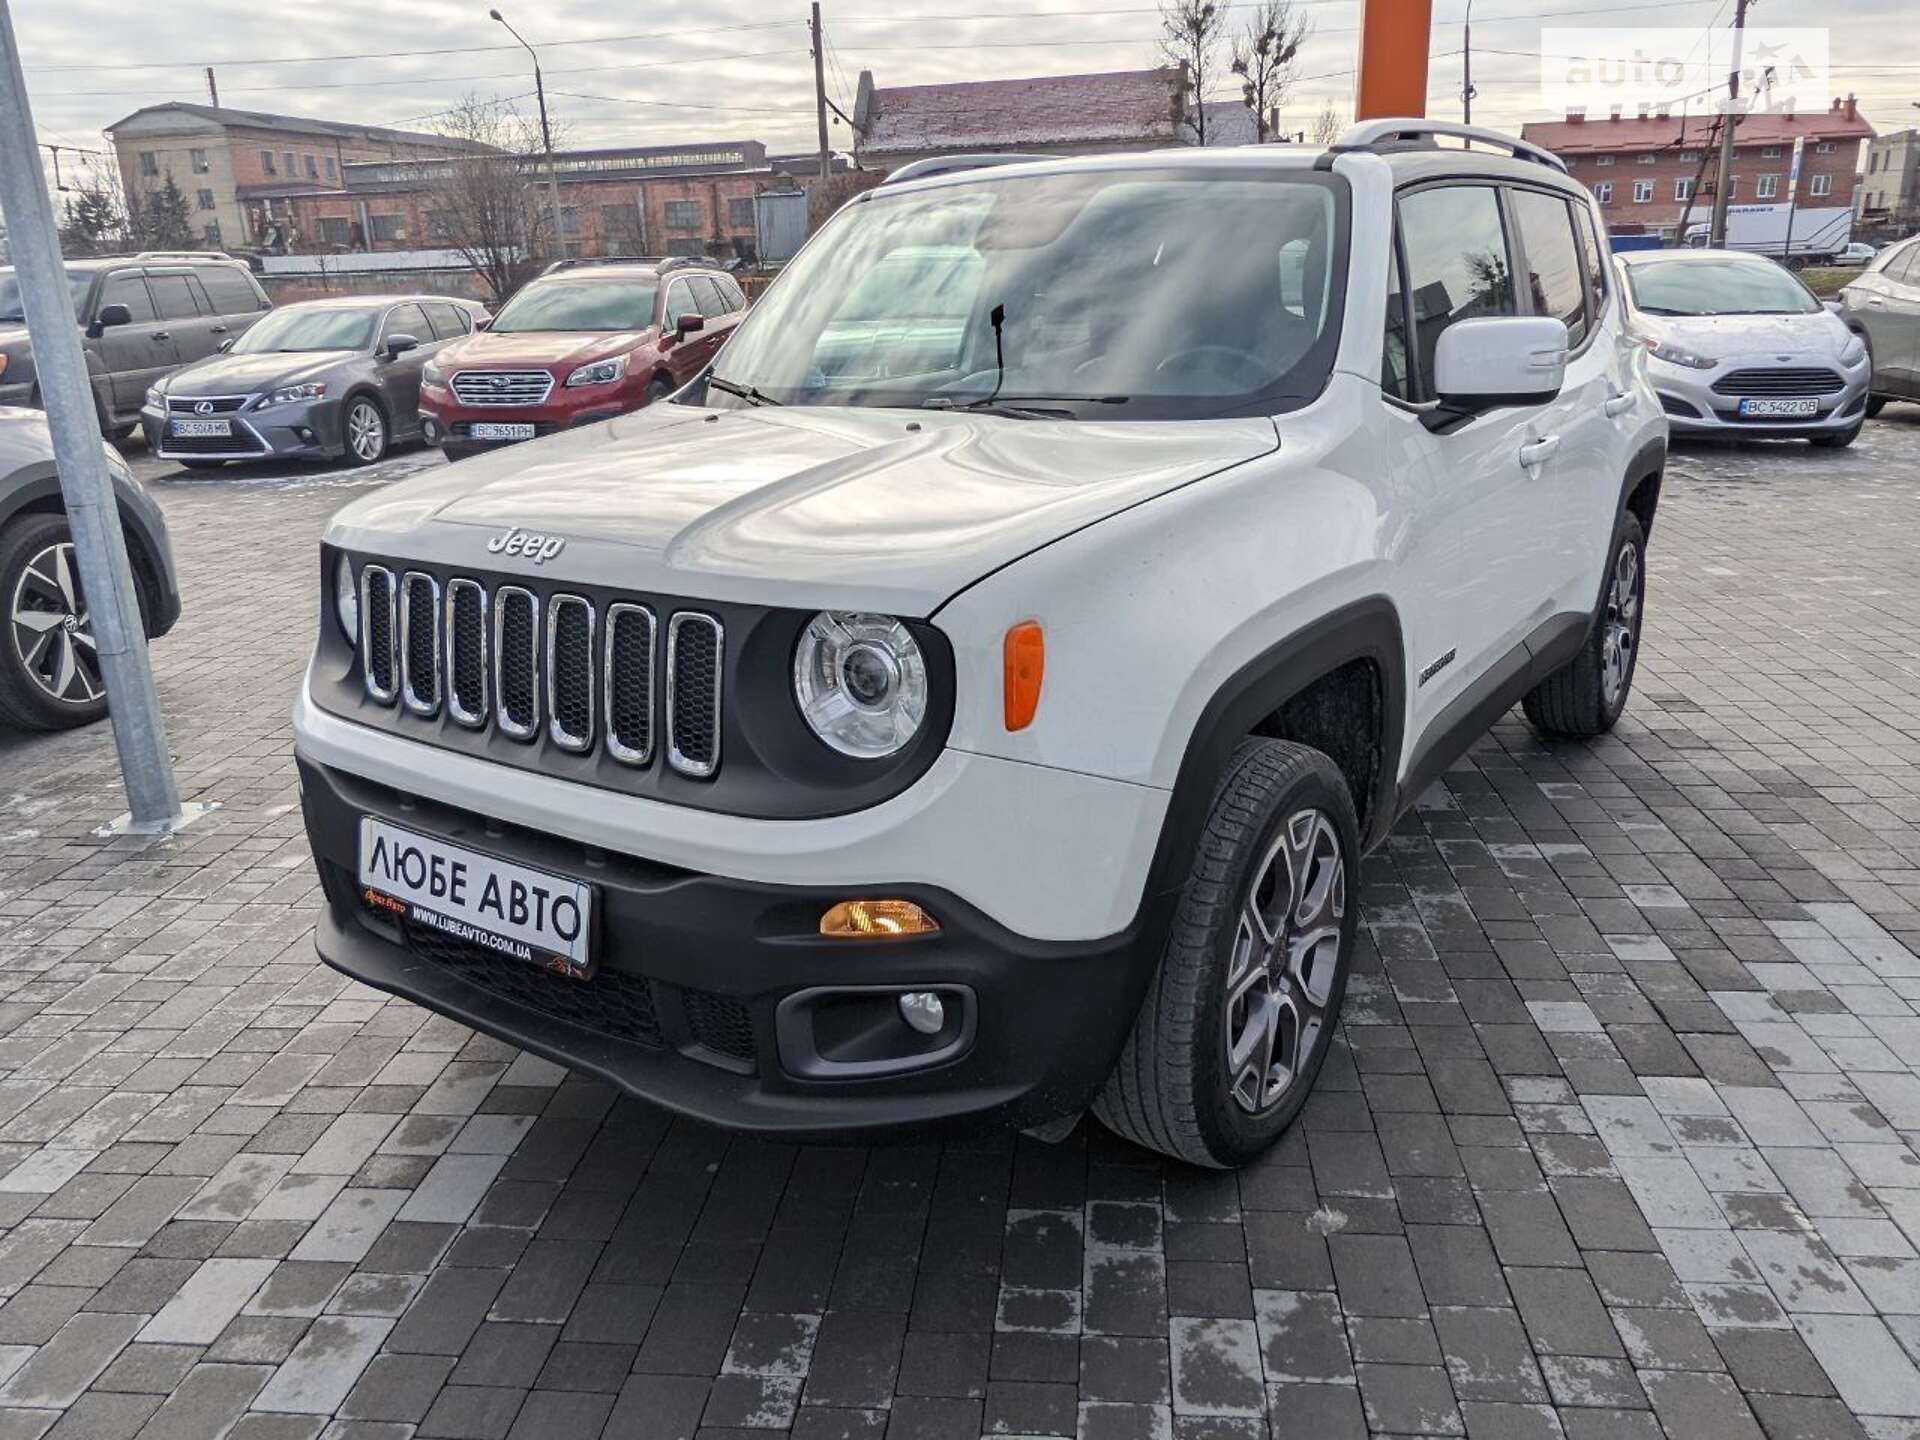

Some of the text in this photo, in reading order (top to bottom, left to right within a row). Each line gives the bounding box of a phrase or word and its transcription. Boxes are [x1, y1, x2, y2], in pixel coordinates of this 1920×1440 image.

[1748, 401, 1766, 413] BC
[1769, 401, 1798, 413] 5422
[478, 425, 492, 437] BC
[487, 526, 566, 565] Jeep
[369, 836, 582, 942] ЛЮБЕ АВТО
[412, 906, 532, 961] WWW.LUBEAVTO.COM.UA
